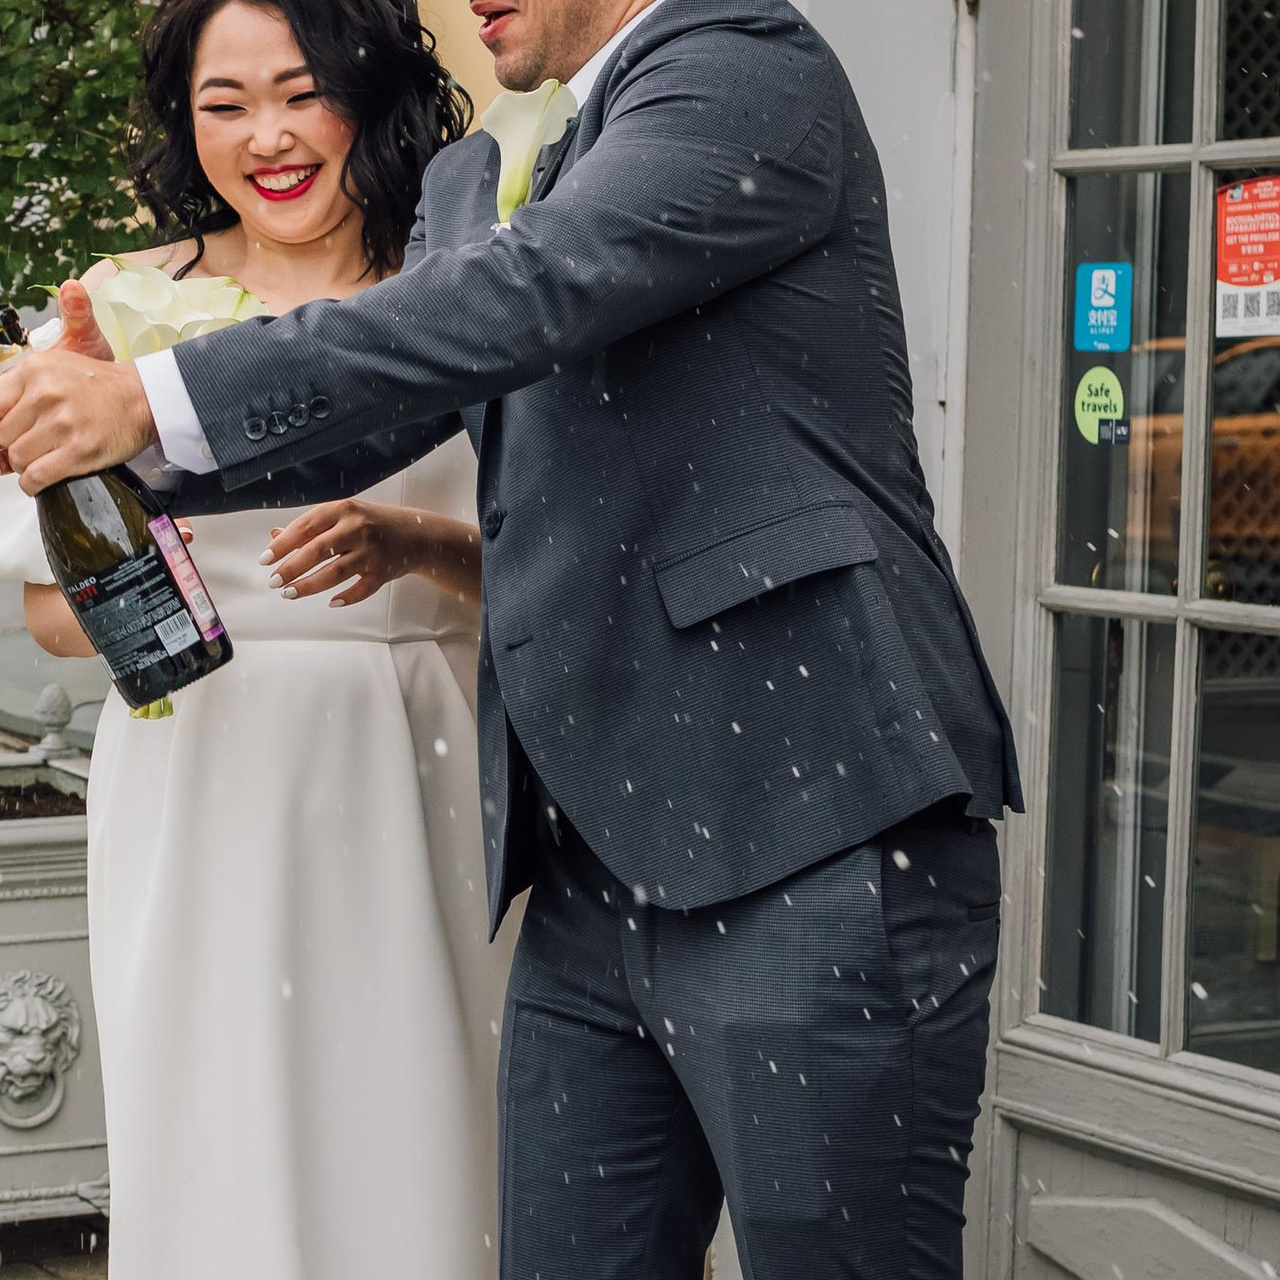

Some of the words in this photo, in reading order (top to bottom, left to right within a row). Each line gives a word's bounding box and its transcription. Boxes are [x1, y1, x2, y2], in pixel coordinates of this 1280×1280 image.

[1225, 234, 1237, 245] GET
[1238, 233, 1249, 243] THE
[1249, 231, 1280, 242] PRIVILEGE
[1088, 309, 1118, 326] 支付宝
[1087, 383, 1110, 398] Safe
[1081, 398, 1118, 413] travels
